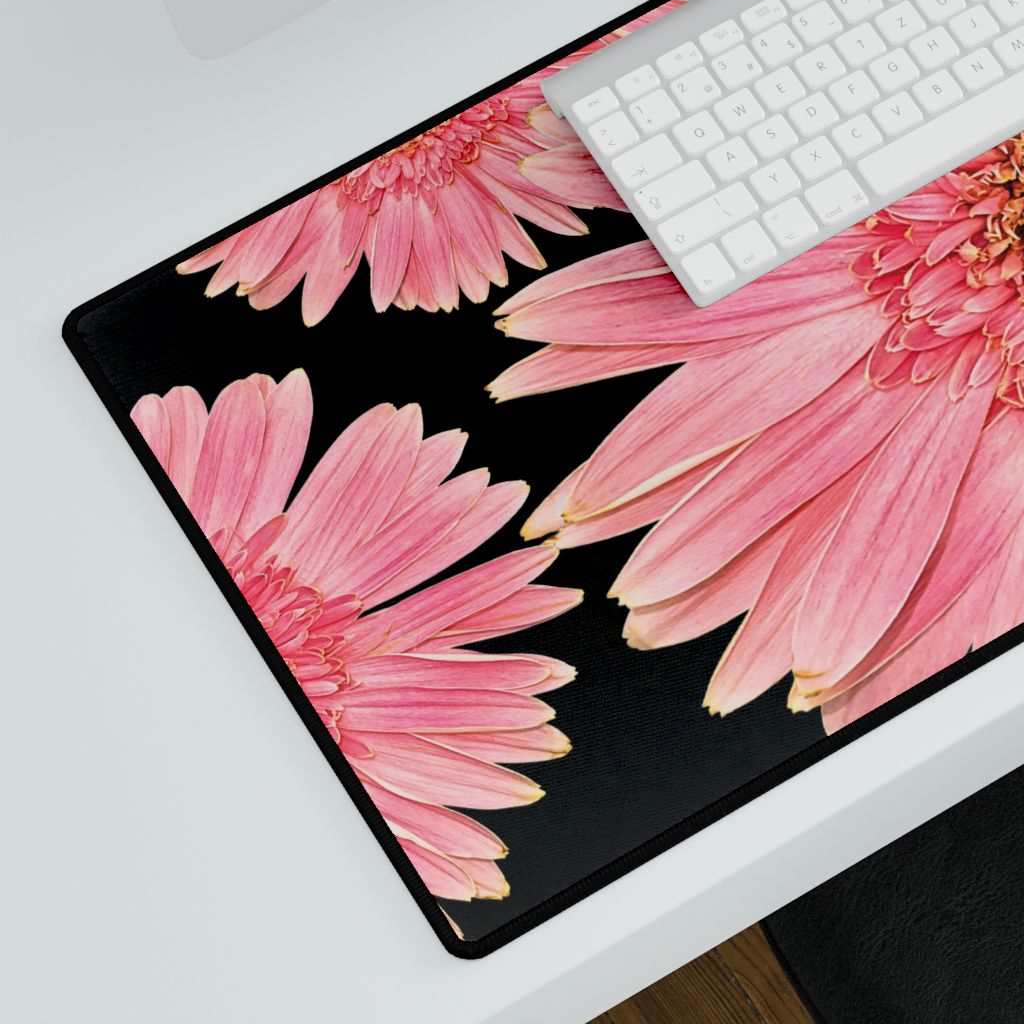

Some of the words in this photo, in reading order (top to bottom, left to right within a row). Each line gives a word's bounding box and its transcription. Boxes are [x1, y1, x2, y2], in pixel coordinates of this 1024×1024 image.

[636, 106, 643, 114] 1
[678, 83, 686, 93] 2
[718, 61, 727, 70] 3
[761, 39, 767, 47] 4
[800, 17, 807, 26] 5
[694, 128, 705, 137] Q
[733, 104, 746, 116] W
[776, 83, 785, 93] E
[817, 62, 826, 71] R
[857, 40, 864, 48] T
[897, 17, 907, 28] Z
[727, 152, 736, 163] A
[767, 129, 775, 139] S
[806, 107, 816, 117] D
[848, 84, 855, 94] F
[888, 62, 898, 72] G
[927, 40, 938, 50] H
[970, 18, 976, 28] J
[769, 173, 777, 183] Y
[810, 151, 821, 161] X
[852, 128, 862, 138] C
[891, 106, 900, 115] V
[932, 85, 942, 94] B
[972, 62, 984, 72] N
[1012, 40, 1024, 51] M
